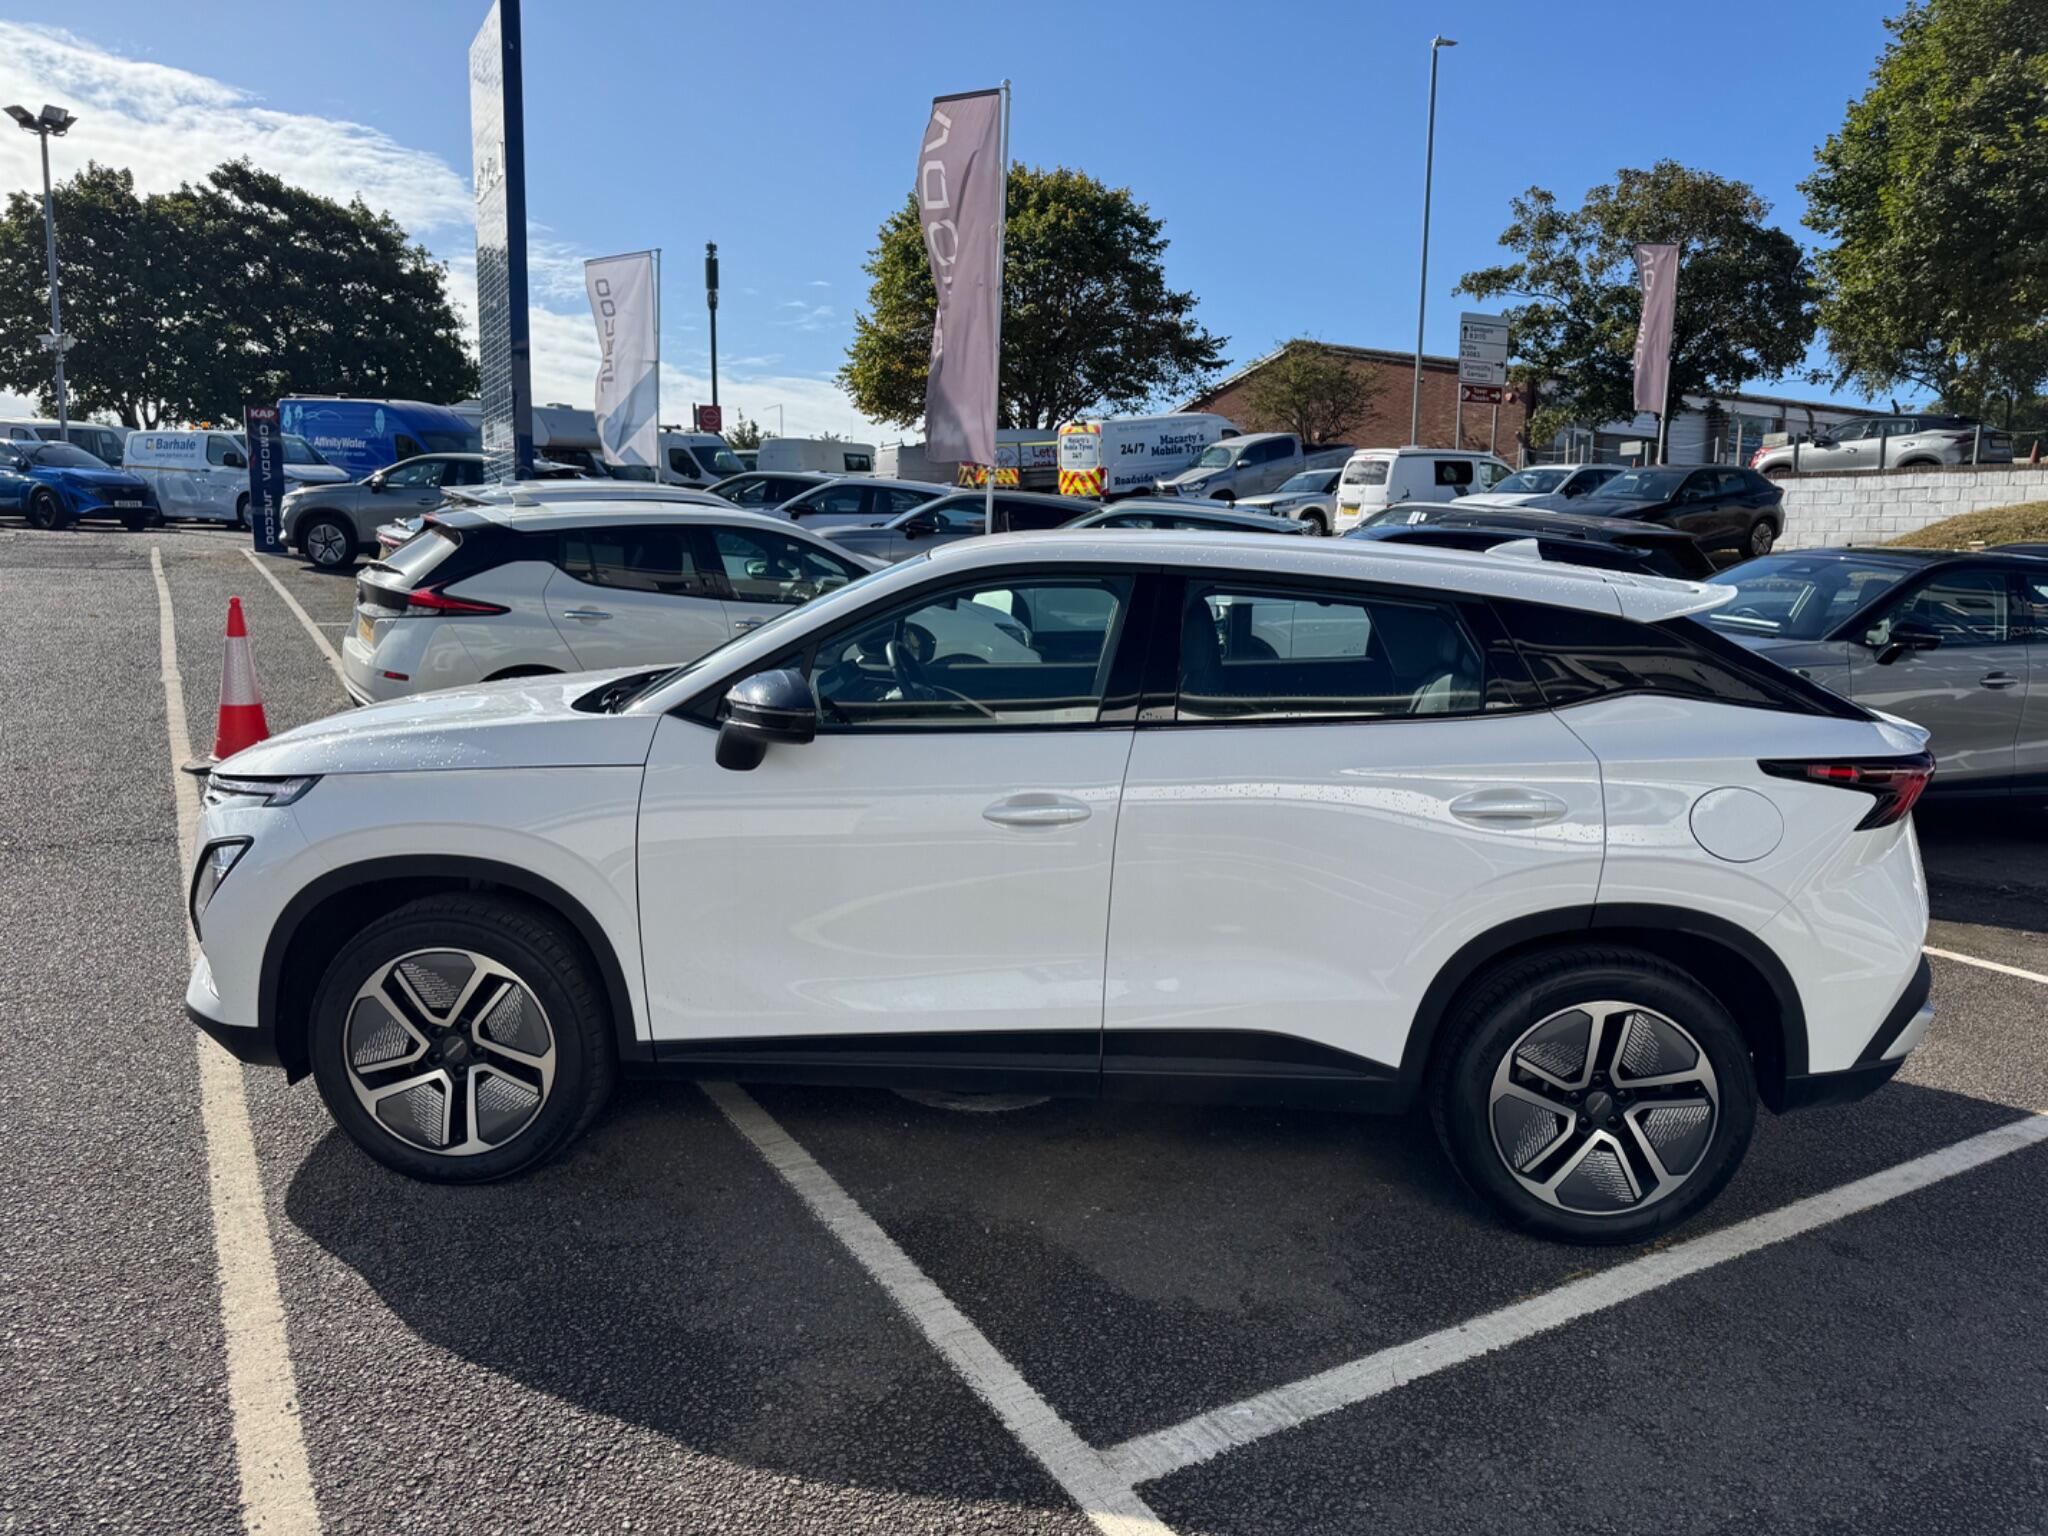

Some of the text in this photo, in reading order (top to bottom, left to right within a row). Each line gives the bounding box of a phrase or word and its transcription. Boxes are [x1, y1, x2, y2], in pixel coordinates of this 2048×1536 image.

[250, 409, 275, 418] KAP
[156, 438, 196, 450] Barhale
[1120, 442, 1145, 455] 24/7
[1151, 443, 1204, 456] Mobile Tyr
[1114, 472, 1154, 486] Roadside
